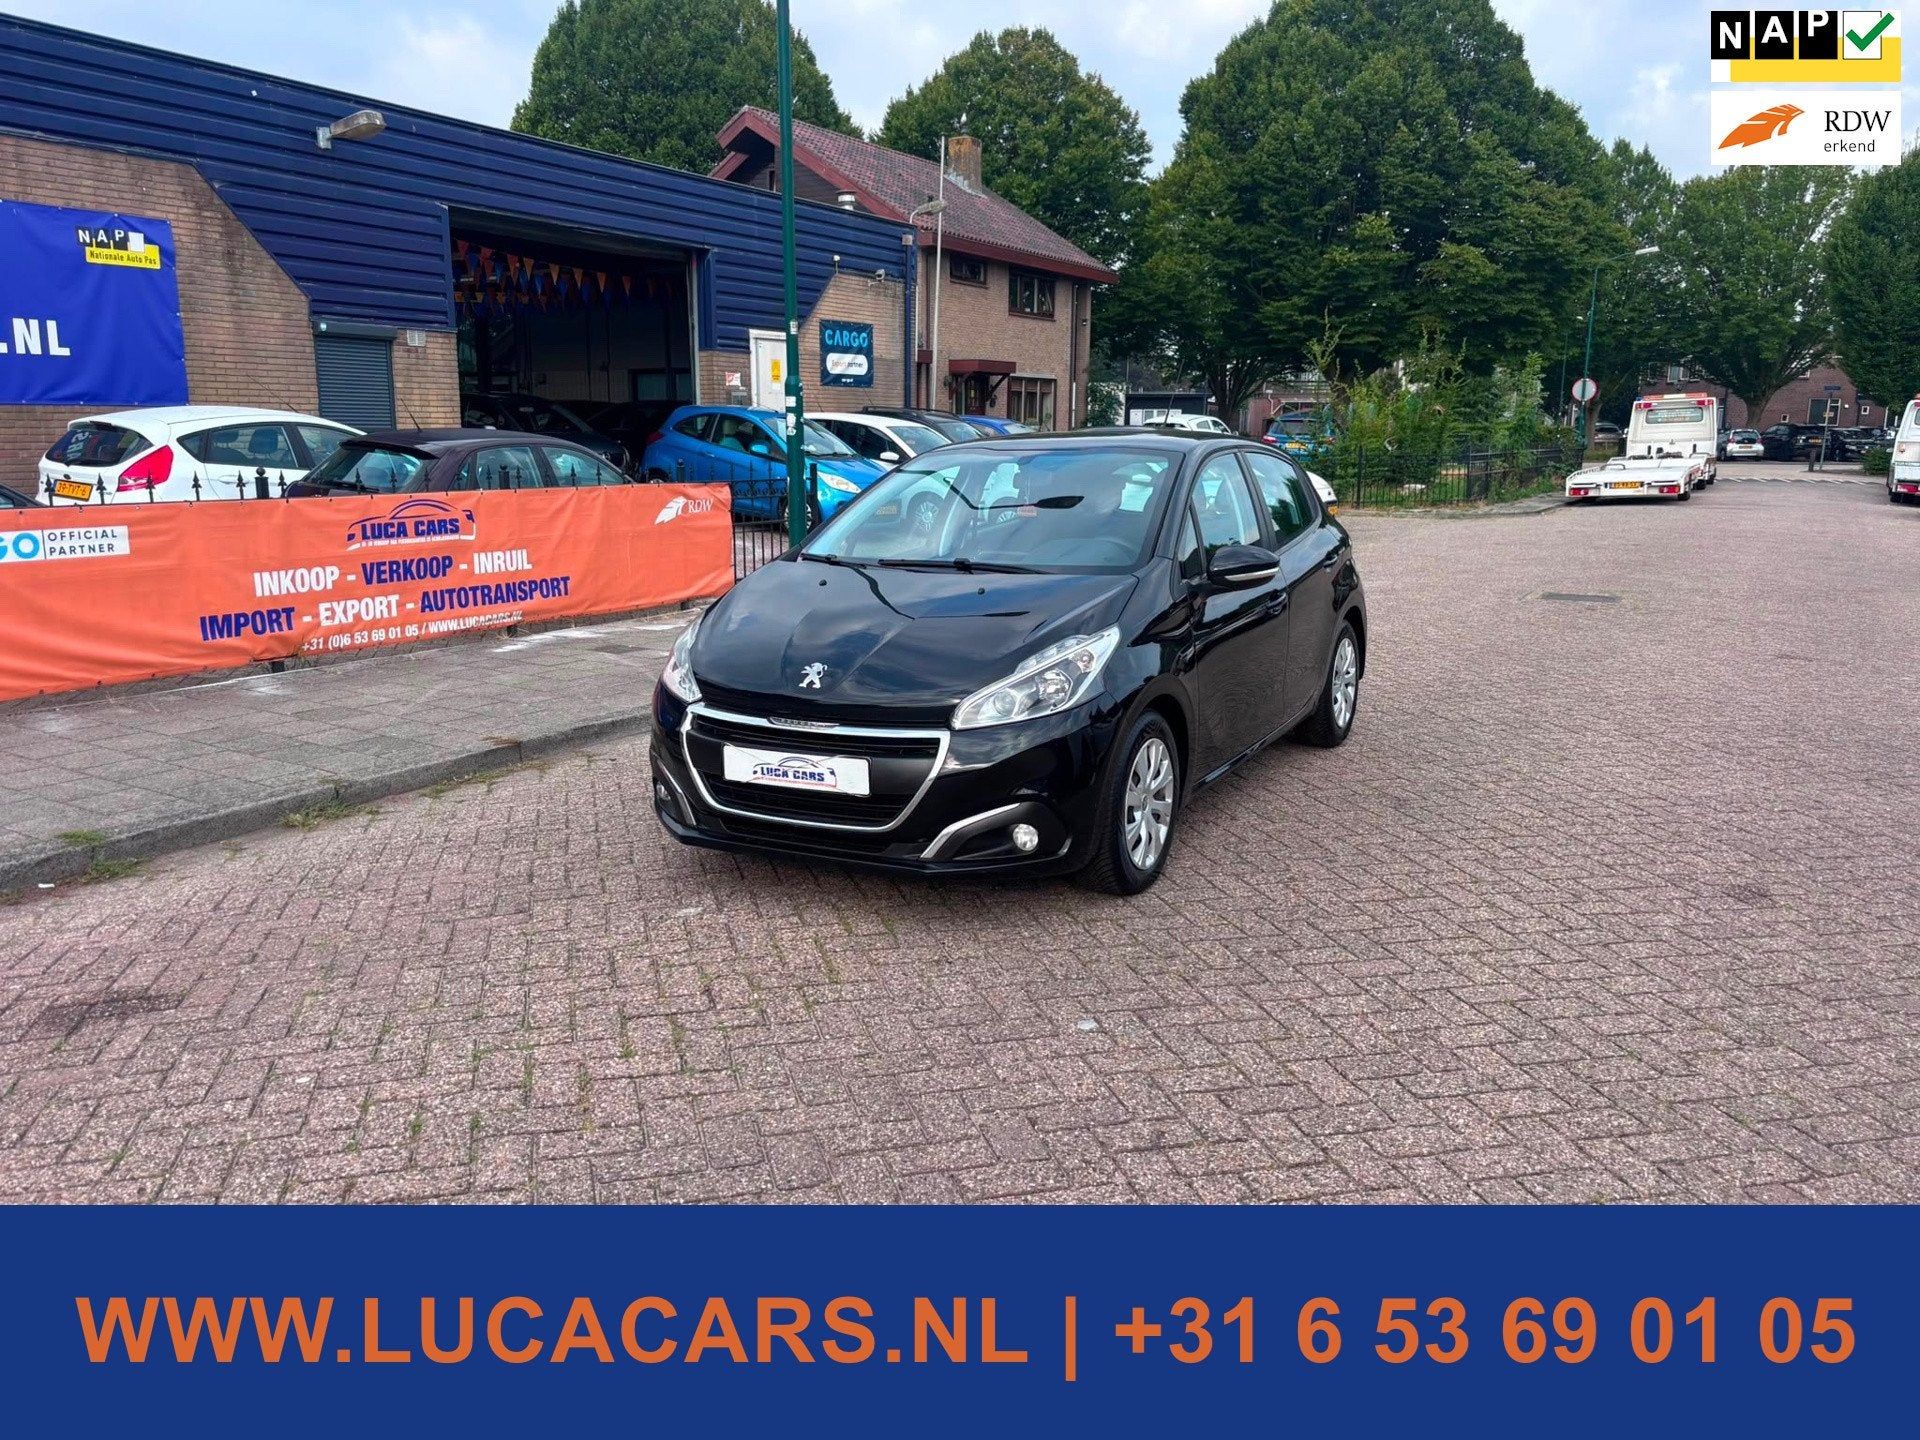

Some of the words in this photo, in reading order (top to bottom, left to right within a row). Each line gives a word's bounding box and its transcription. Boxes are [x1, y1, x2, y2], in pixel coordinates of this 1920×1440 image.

[78, 229, 124, 243] NAP
[89, 250, 125, 262] Nationale
[127, 254, 143, 264] Auto
[144, 255, 157, 265] Pas
[825, 329, 868, 348] CARGO
[688, 498, 714, 513] RDW
[47, 529, 118, 542] OFFICIAL
[361, 521, 409, 540] LUCA
[414, 518, 460, 537] CARS
[49, 543, 115, 556] PARTNER
[253, 565, 340, 597] INKOOP
[361, 555, 454, 586] VERKOOP
[473, 549, 533, 575] INRUIL
[199, 606, 295, 642] IMPORT
[319, 594, 400, 627] EXPORT
[420, 576, 571, 613] AUTOTRANSPORT
[302, 637, 324, 652] +31
[328, 634, 351, 649] (0)6
[354, 630, 369, 644] 53
[371, 627, 386, 642] 69
[388, 626, 401, 640] 01
[405, 624, 419, 638] 05
[760, 766, 789, 779] LUCA
[793, 770, 825, 782] CARS
